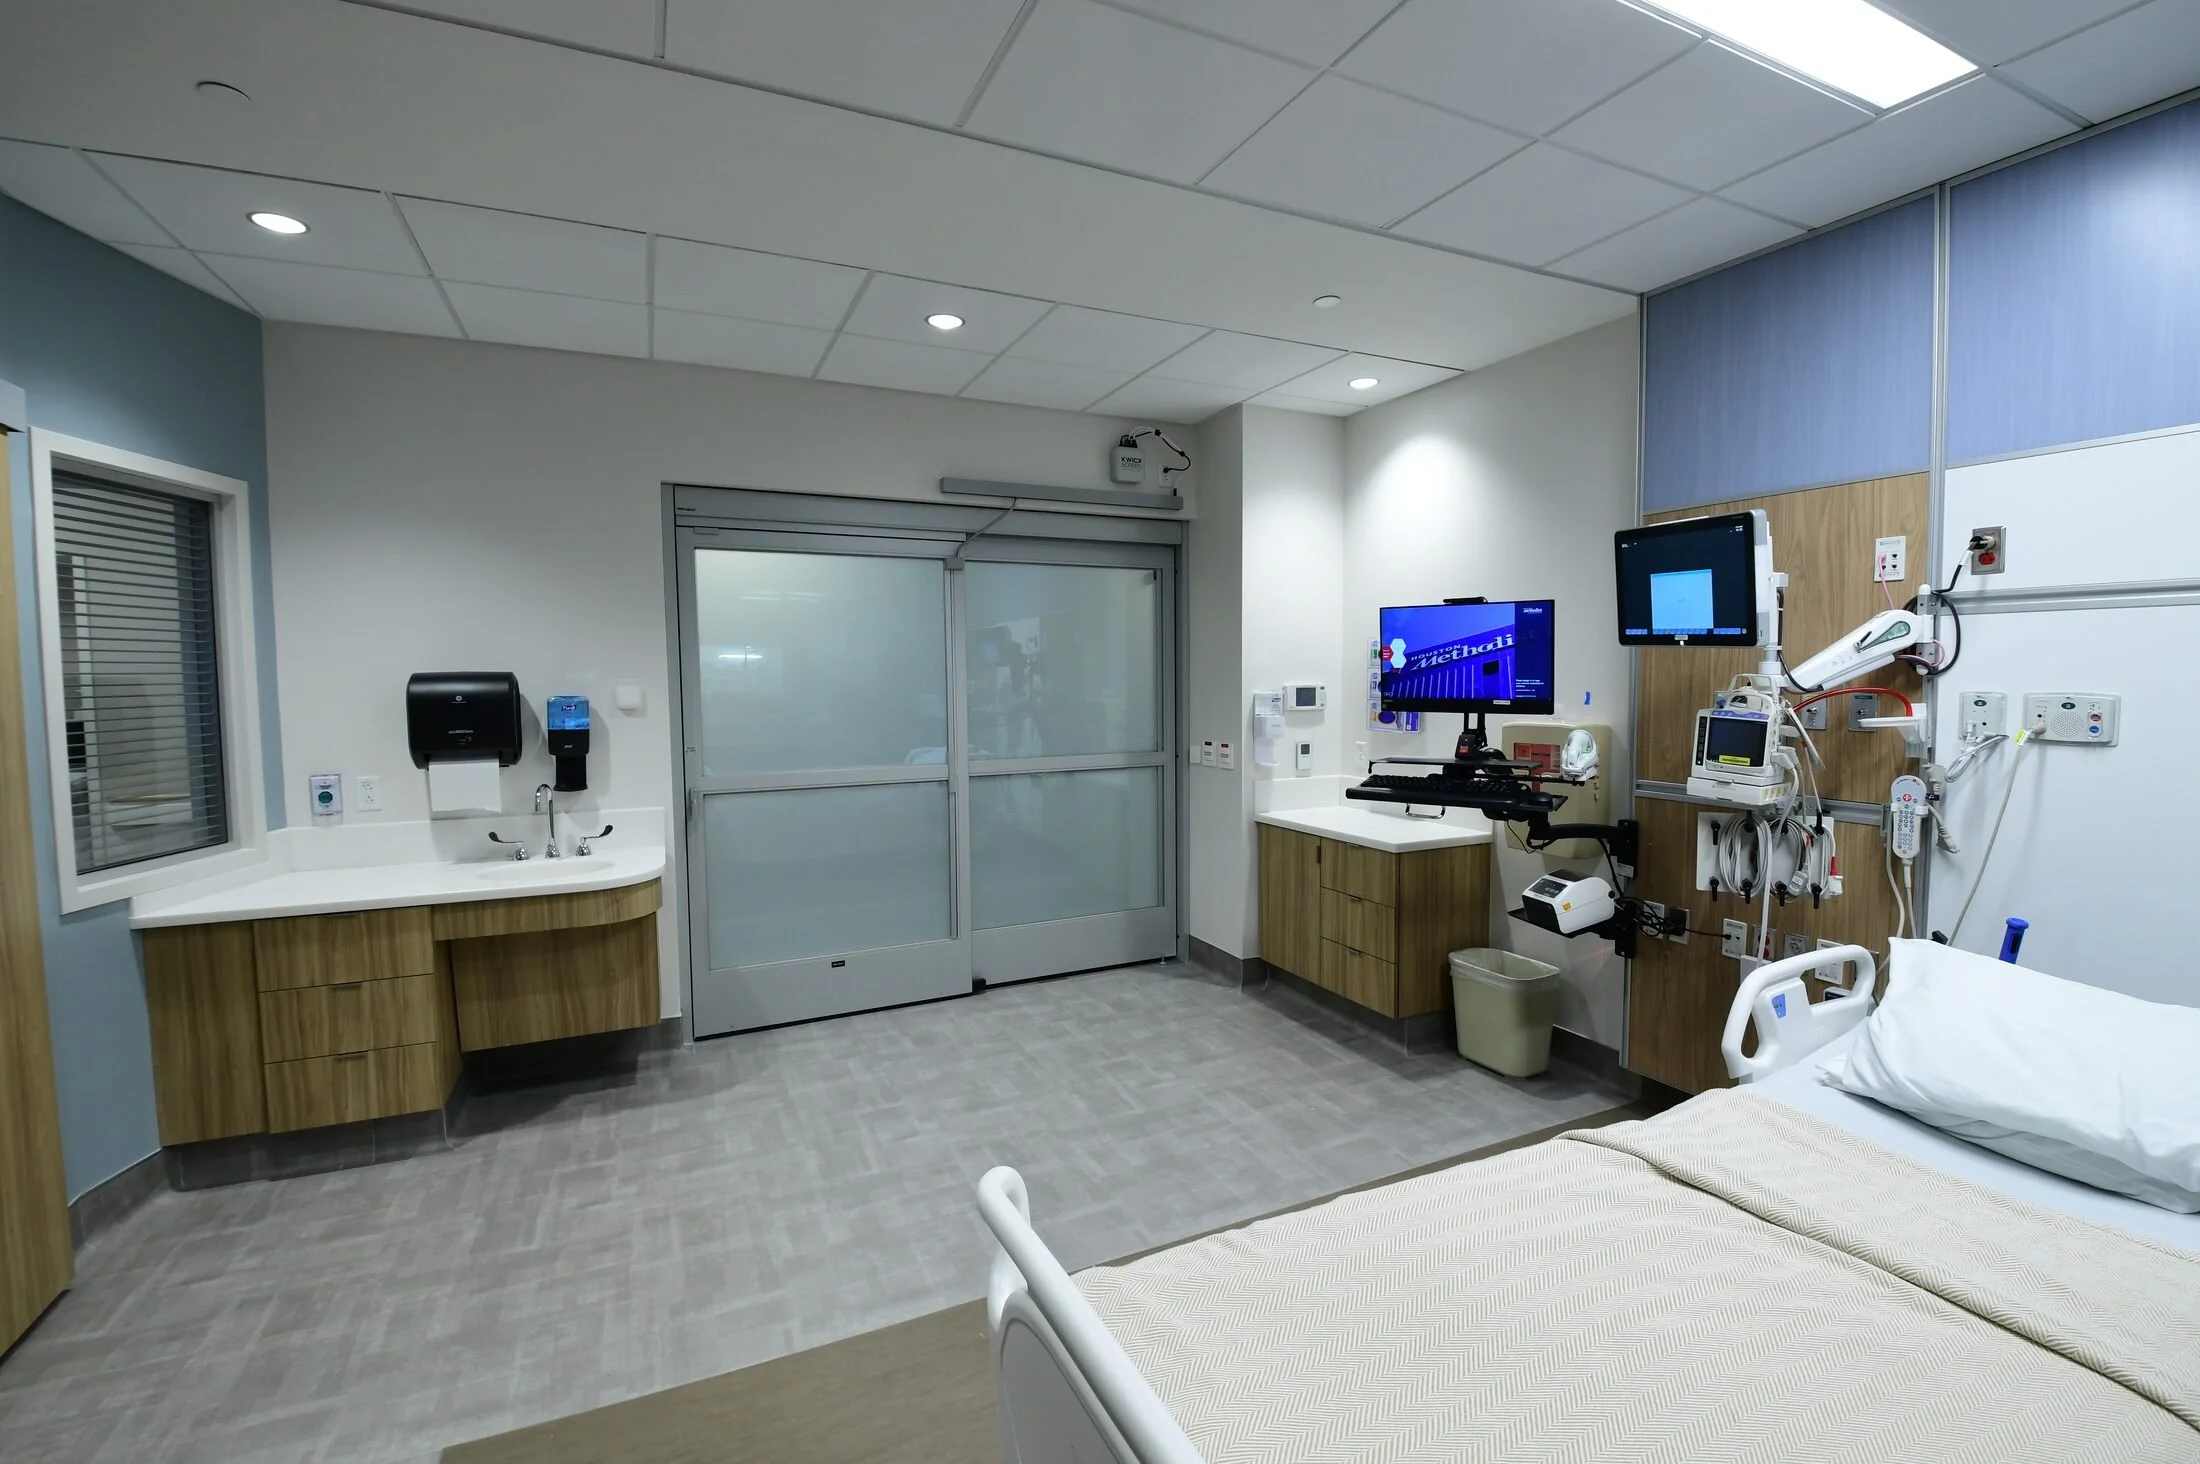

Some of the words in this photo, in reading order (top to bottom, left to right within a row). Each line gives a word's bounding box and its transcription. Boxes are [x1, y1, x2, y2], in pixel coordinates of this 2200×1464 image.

[1120, 456, 1142, 464] KWICK
[1410, 633, 1515, 671] Methodi
[1411, 644, 1461, 661] HOUSTON
